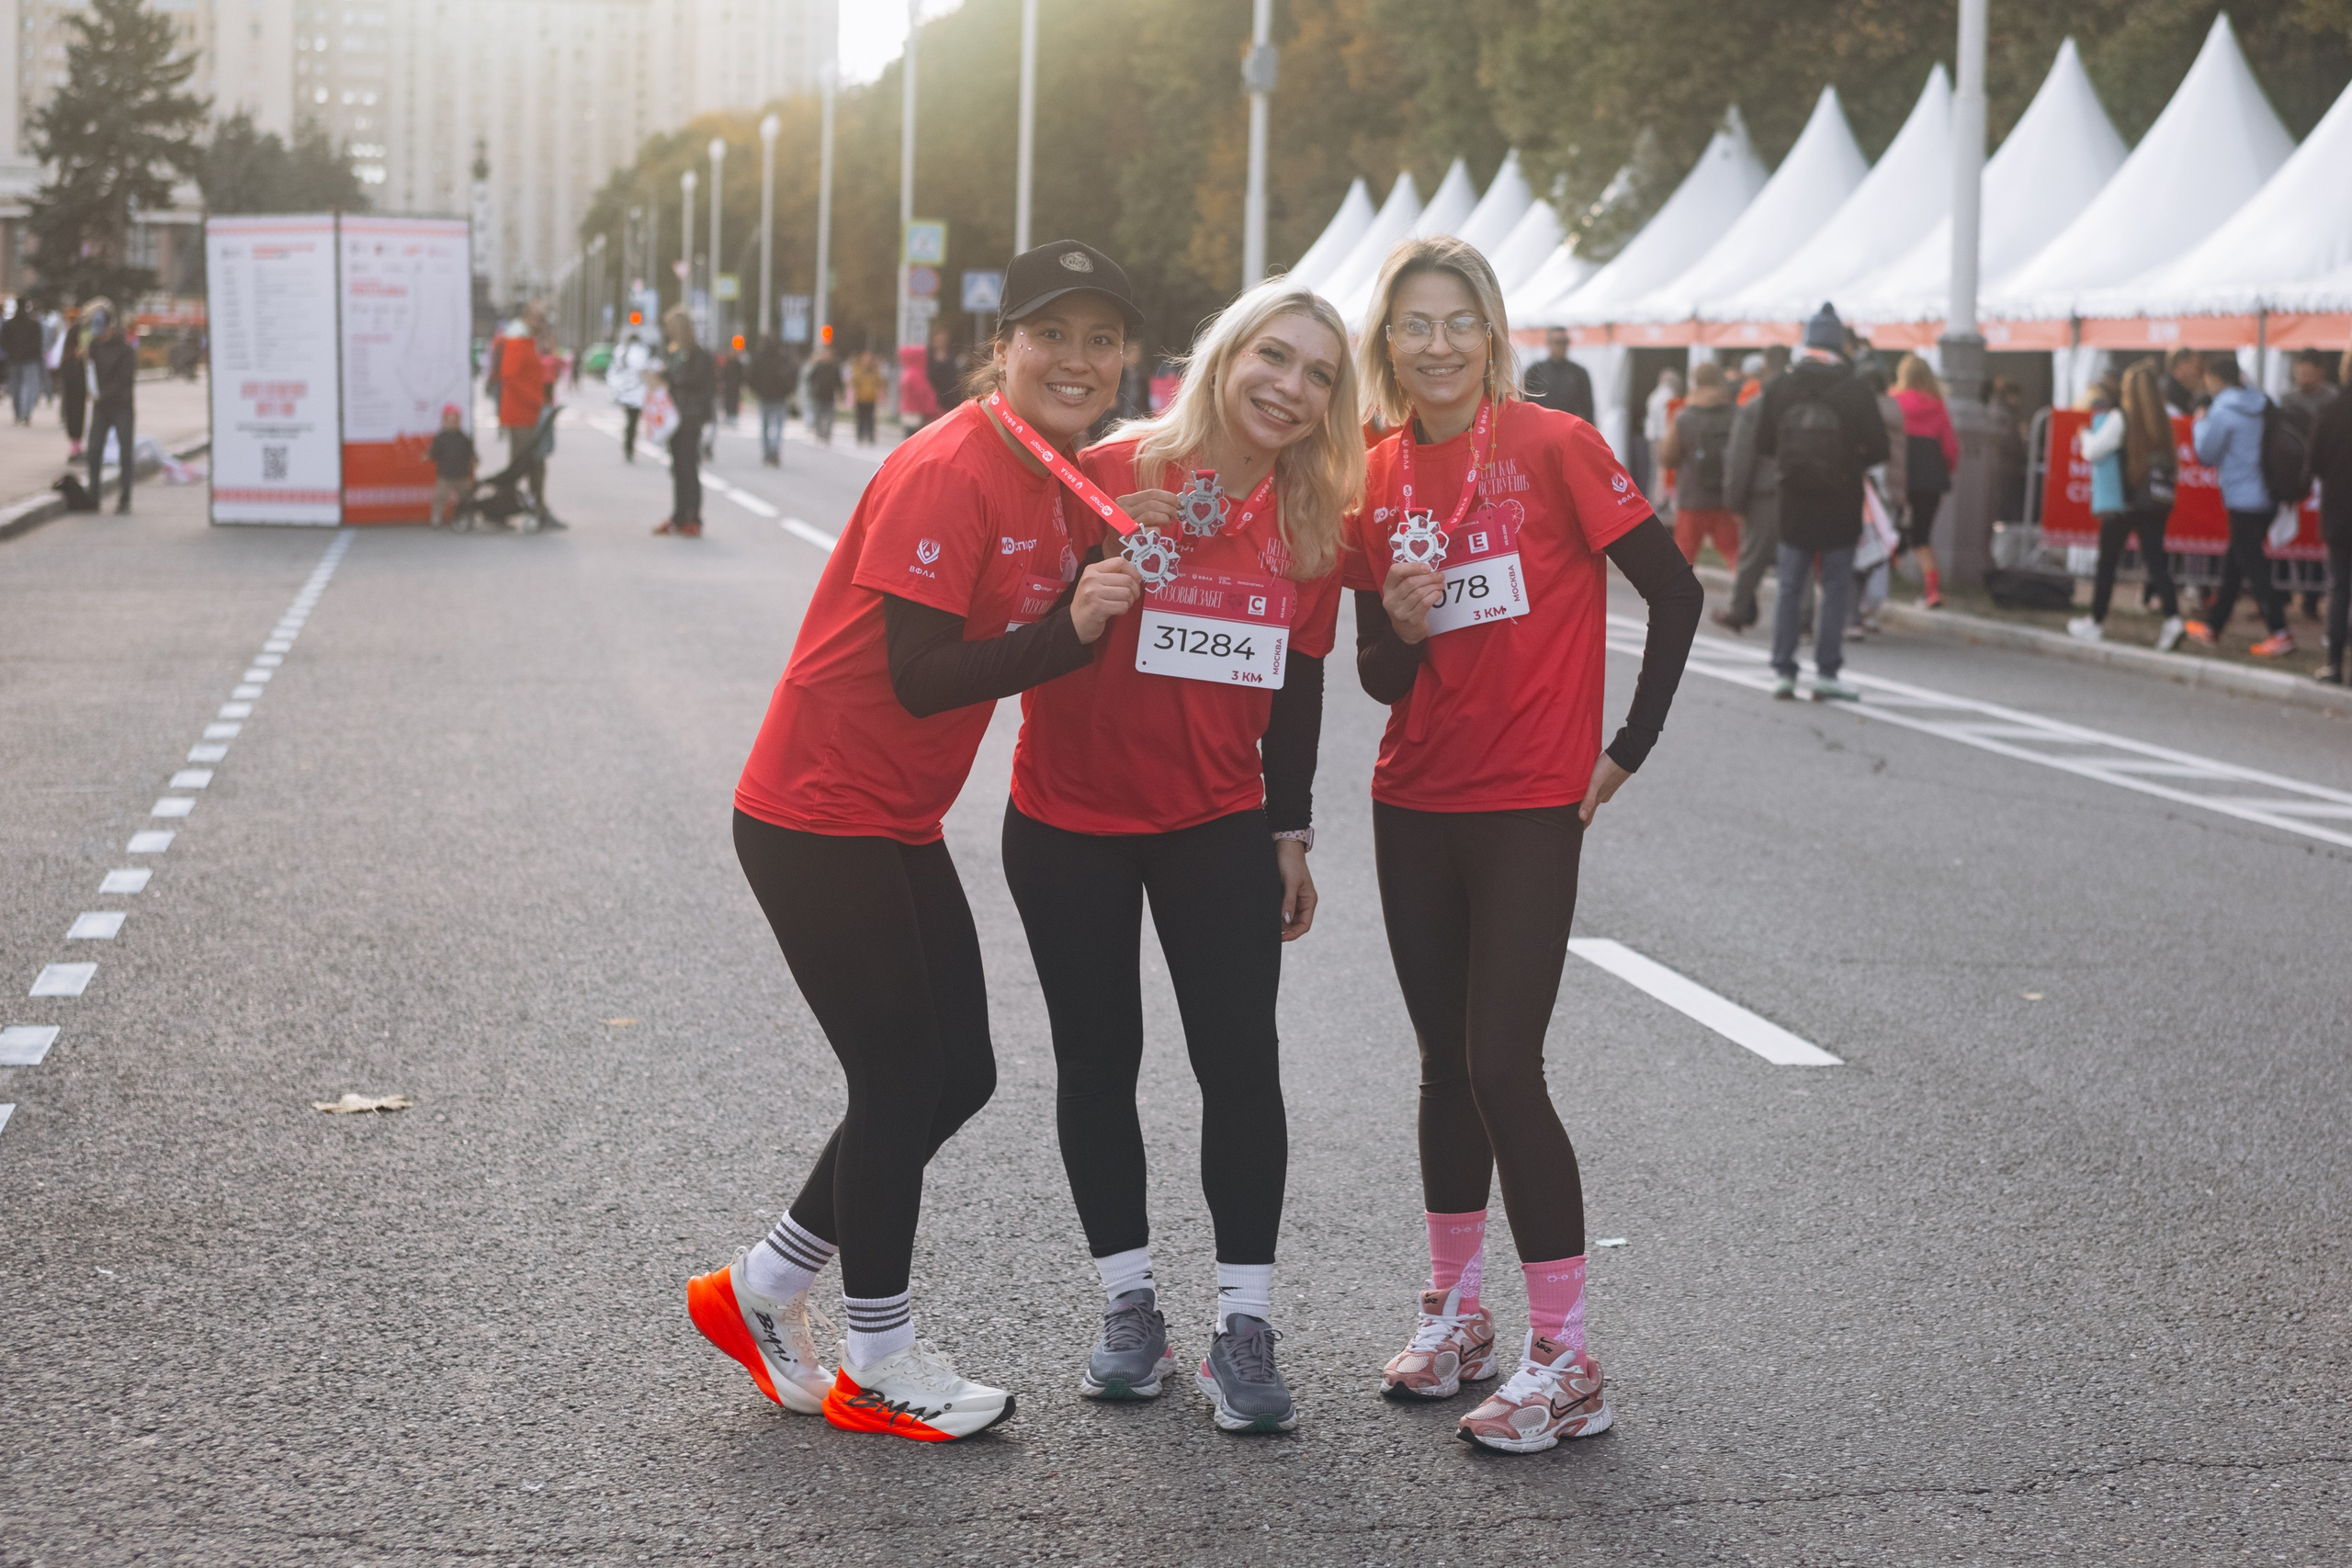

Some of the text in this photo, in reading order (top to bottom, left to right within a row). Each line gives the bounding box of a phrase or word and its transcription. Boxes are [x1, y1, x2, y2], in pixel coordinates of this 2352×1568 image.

[1060, 467, 1077, 483] ВФЛА
[1498, 457, 1517, 477] КАК
[1478, 474, 1530, 496] ВСТВУЕШЬ
[1617, 491, 1636, 506] ВФЛА
[910, 565, 935, 580] ВФЛА
[1508, 565, 1521, 603] МОСКВА
[1198, 589, 1225, 609] ЗАБЕГ
[1474, 610, 1481, 621] 3
[1153, 625, 1256, 660] 31284
[1272, 637, 1283, 675] МОСКВА
[1231, 671, 1238, 681] 3
[1534, 1341, 1554, 1355] NIKE
